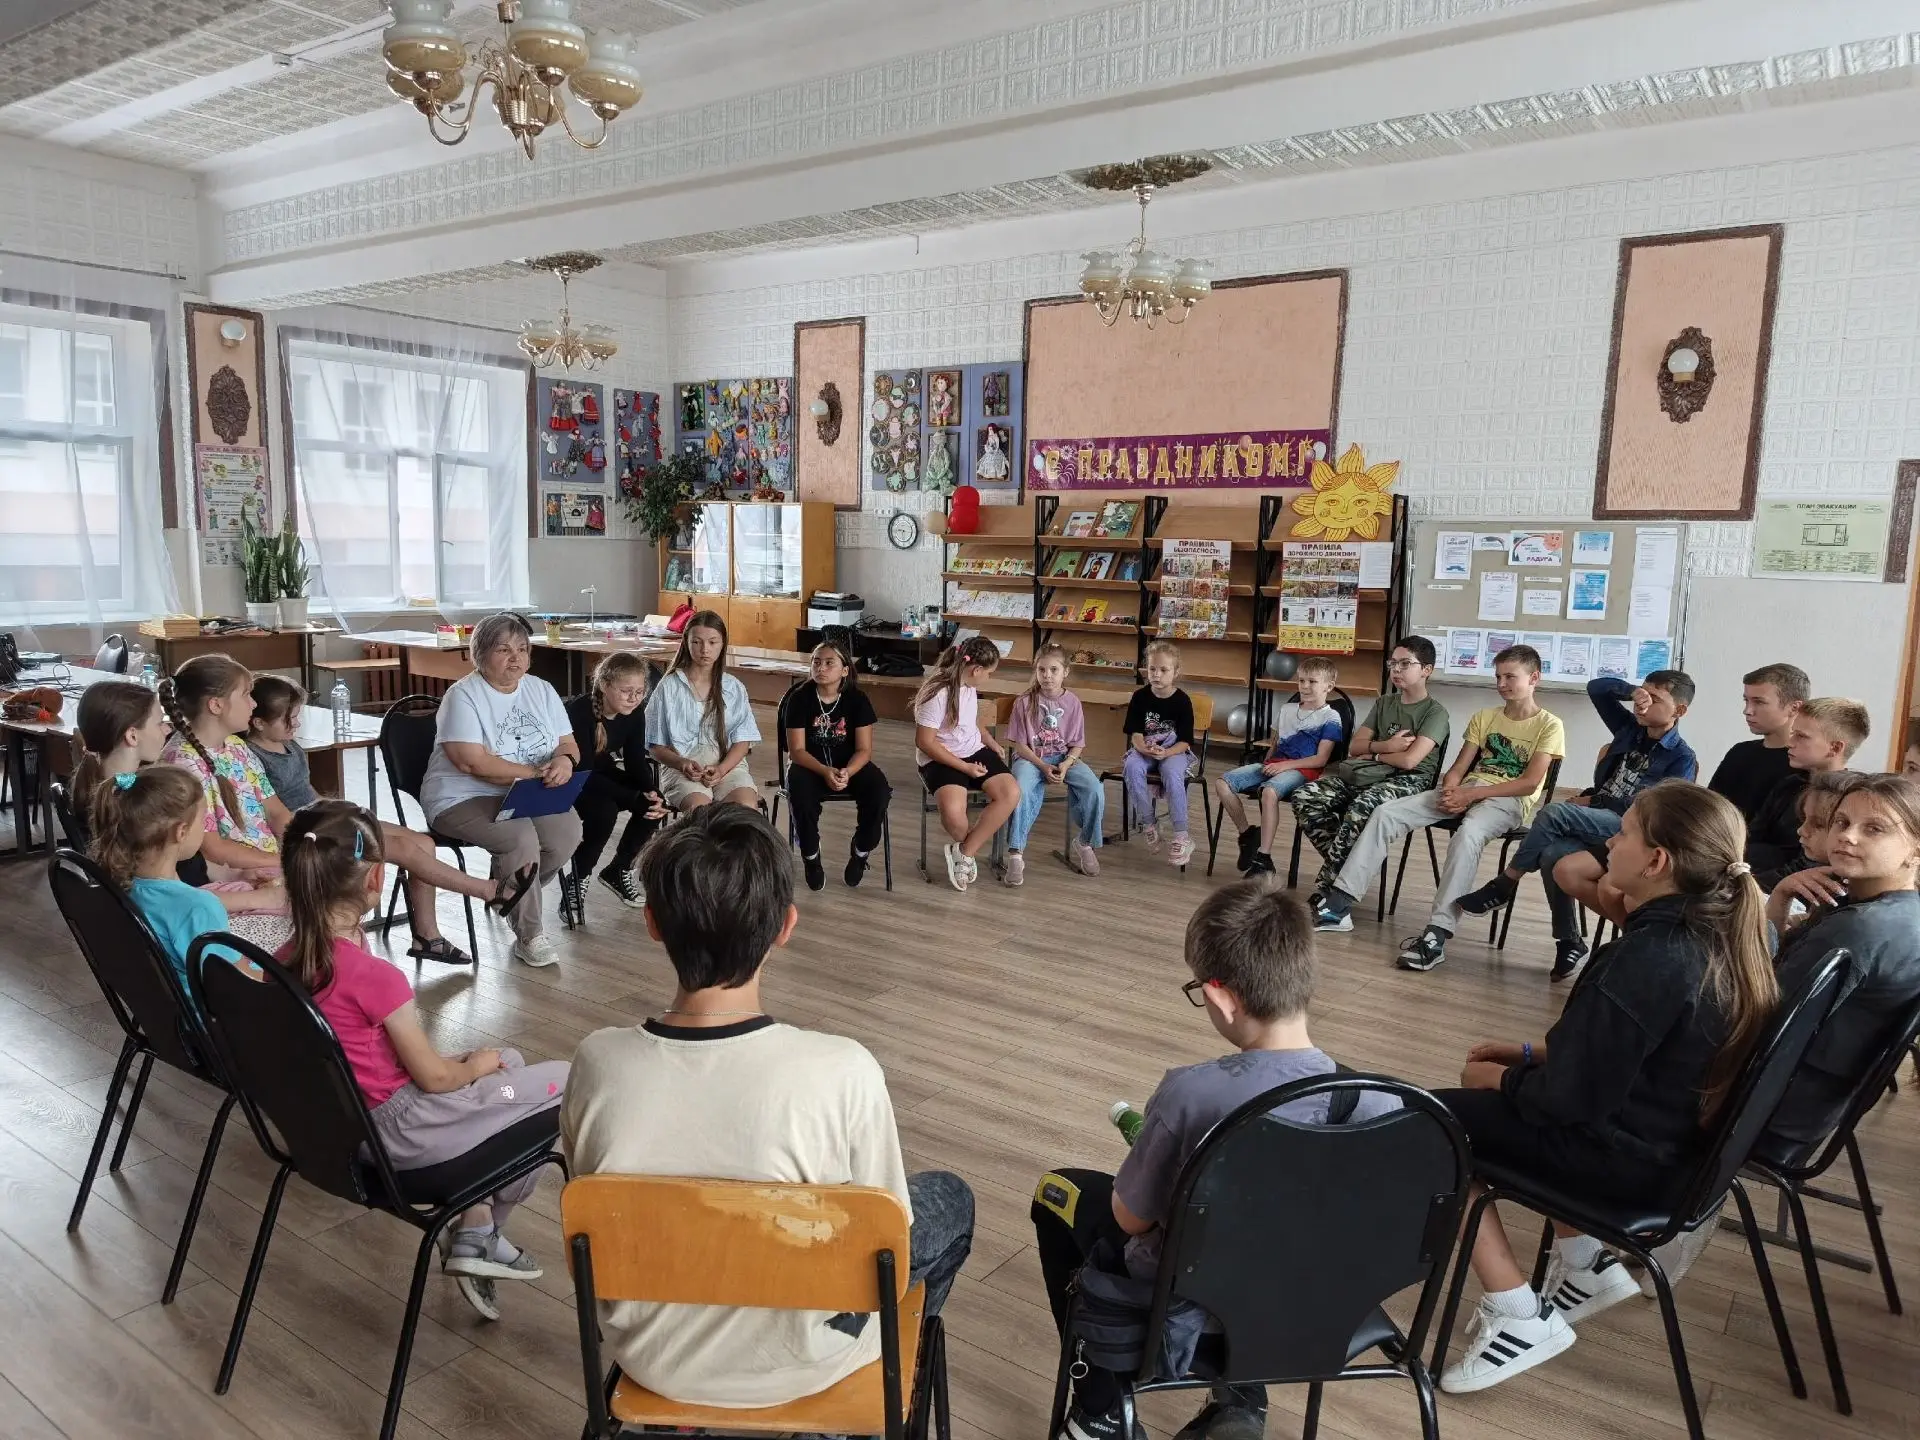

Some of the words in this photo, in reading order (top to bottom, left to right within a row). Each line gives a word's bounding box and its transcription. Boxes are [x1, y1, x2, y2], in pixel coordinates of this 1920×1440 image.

[1045, 450, 1060, 480] С
[1076, 441, 1311, 485] ПРАЗДНИКОМ!
[1178, 540, 1216, 548] ПРАВИЛА
[1301, 543, 1343, 551] ПРАВИЛА
